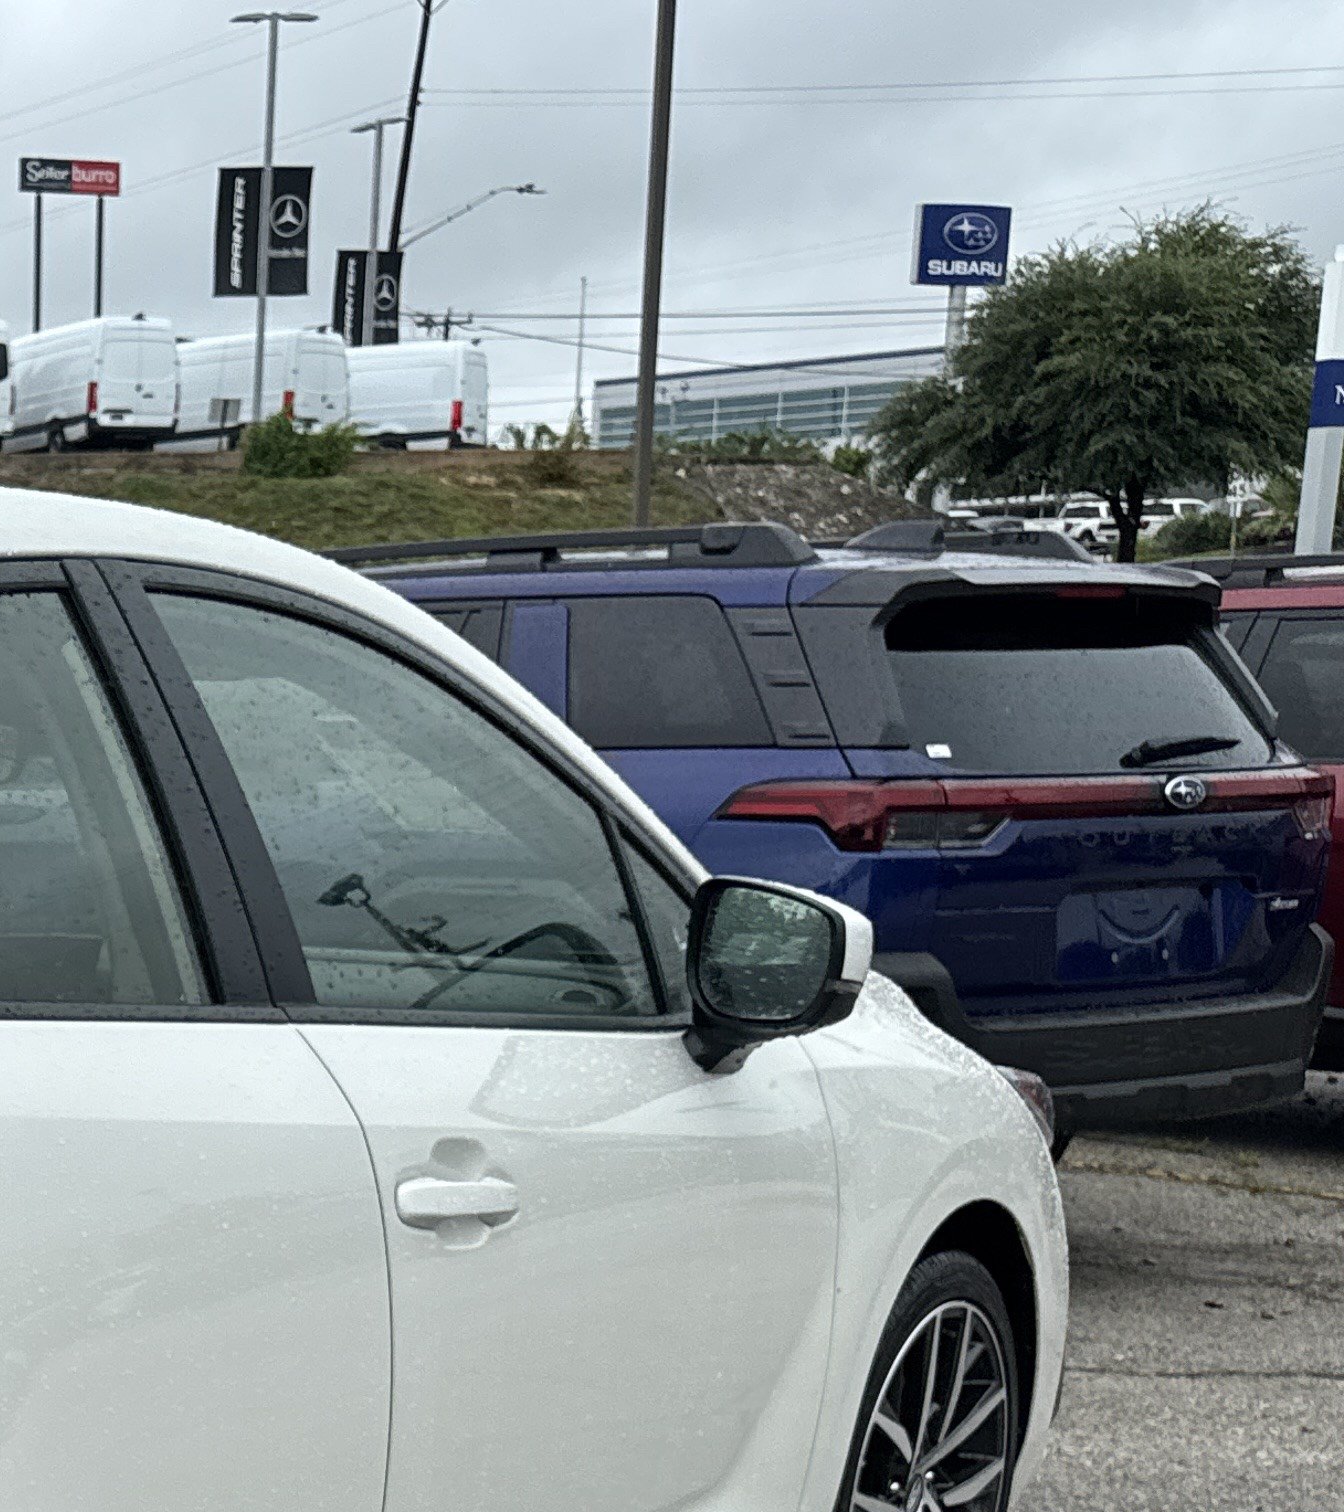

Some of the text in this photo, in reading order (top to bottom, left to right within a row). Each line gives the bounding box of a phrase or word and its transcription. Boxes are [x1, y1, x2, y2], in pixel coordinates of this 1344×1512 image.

[71, 163, 117, 184] burro
[231, 176, 246, 289] SPRINTER
[928, 259, 1003, 277] SUBARU
